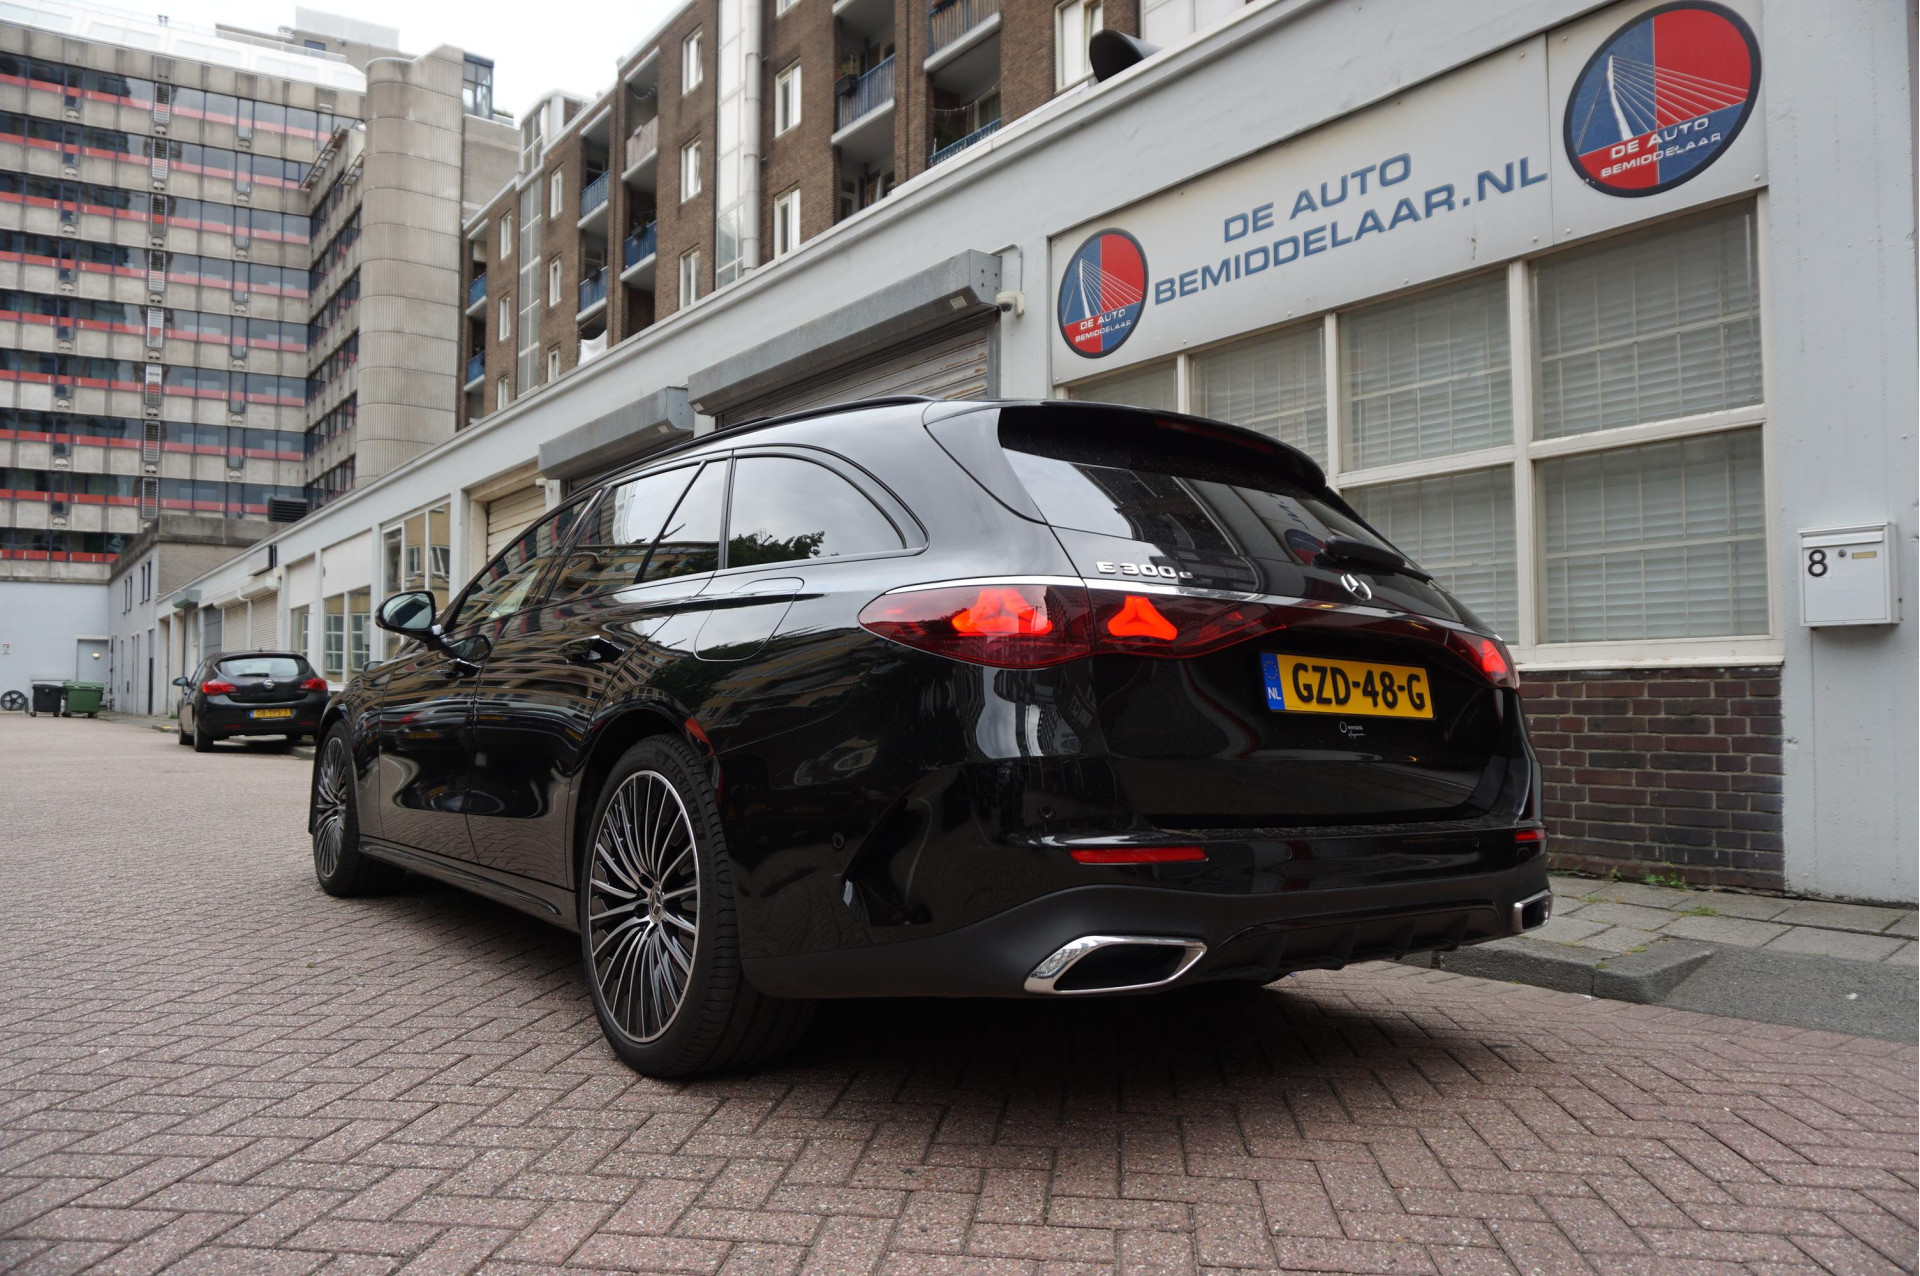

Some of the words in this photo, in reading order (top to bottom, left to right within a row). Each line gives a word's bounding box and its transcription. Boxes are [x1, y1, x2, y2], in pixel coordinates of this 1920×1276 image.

[1601, 132, 1722, 178] BEMIDDELAAR
[1611, 139, 1640, 159] DE
[1647, 117, 1709, 148] AUTO
[1224, 201, 1275, 243] DE
[1289, 153, 1412, 221] AUTO
[1155, 156, 1548, 306] BEMIDDELAAR.NL
[1075, 319, 1131, 342] BEMIDDELAAR
[1080, 318, 1094, 330] DE
[1097, 308, 1126, 325] AUTO
[1096, 561, 1117, 574] E
[1808, 549, 1828, 577] 8
[1267, 686, 1282, 700] NL
[1292, 662, 1426, 711] GZD-48-G
